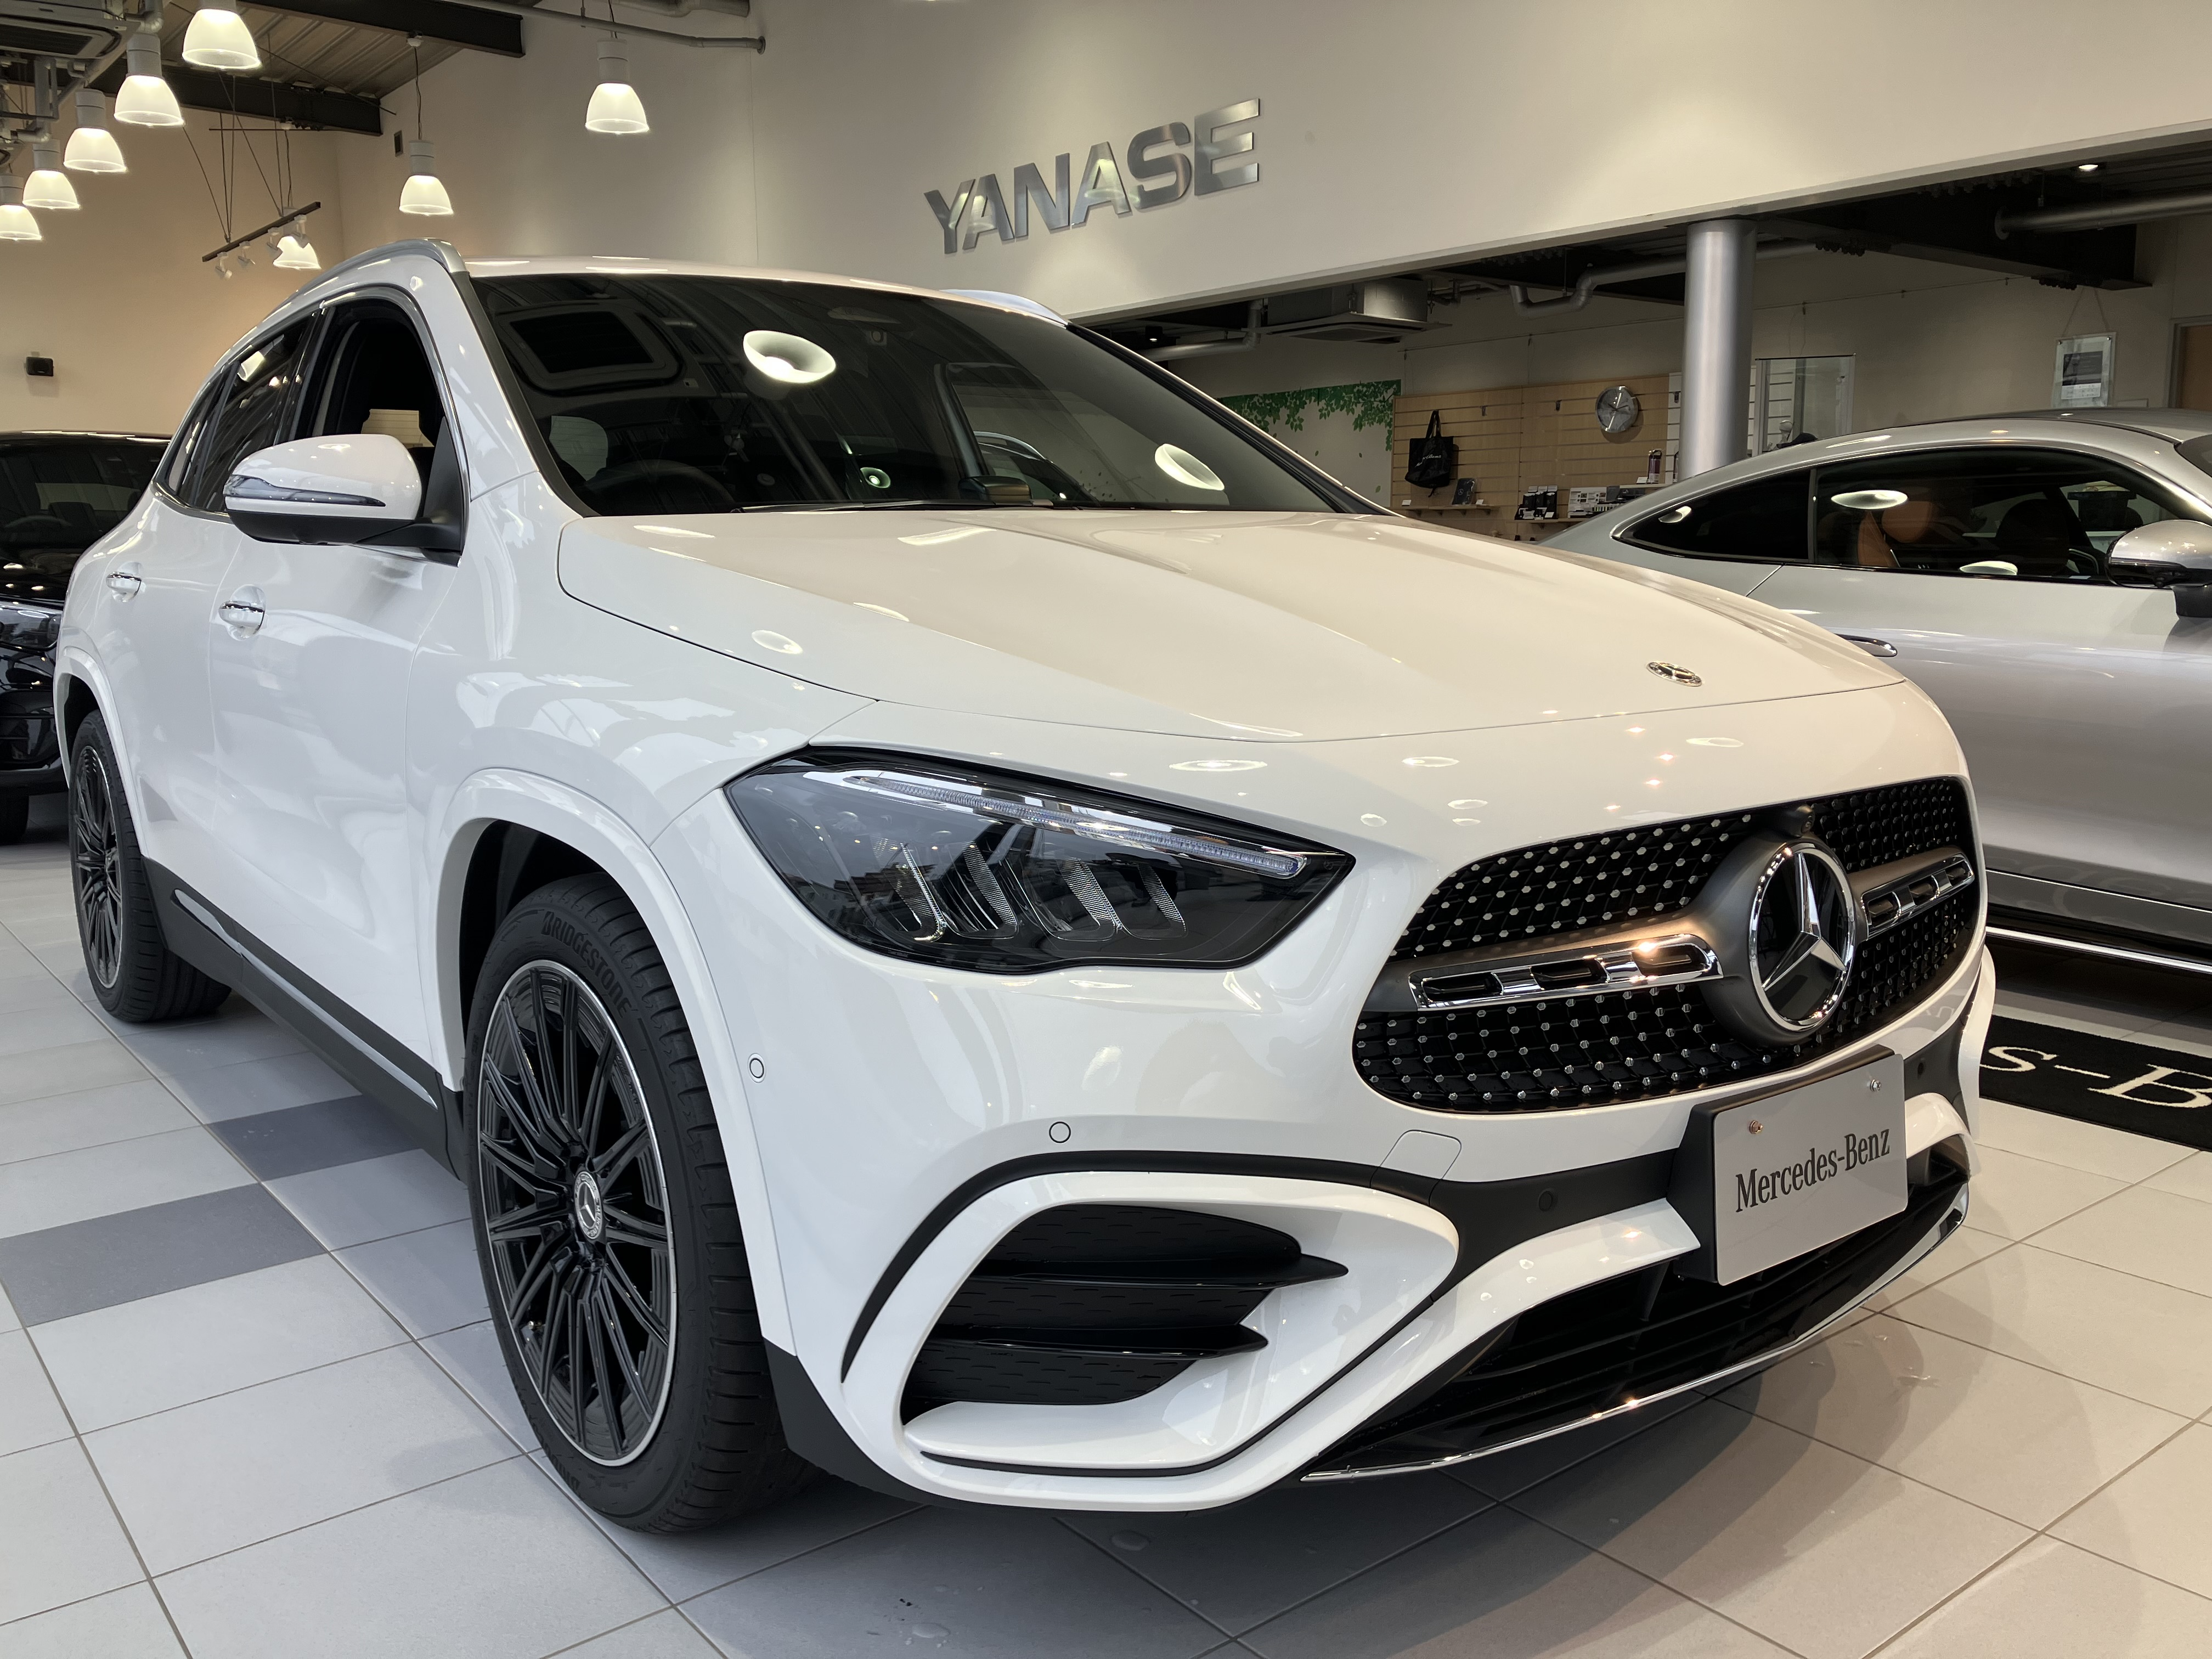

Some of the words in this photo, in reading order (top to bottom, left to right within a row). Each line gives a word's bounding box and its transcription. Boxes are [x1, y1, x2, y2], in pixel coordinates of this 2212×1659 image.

[924, 98, 1260, 254] YANASE
[541, 911, 633, 1019] BRIDGESTONE
[1735, 1128, 1890, 1212] Mercedes-Benz
